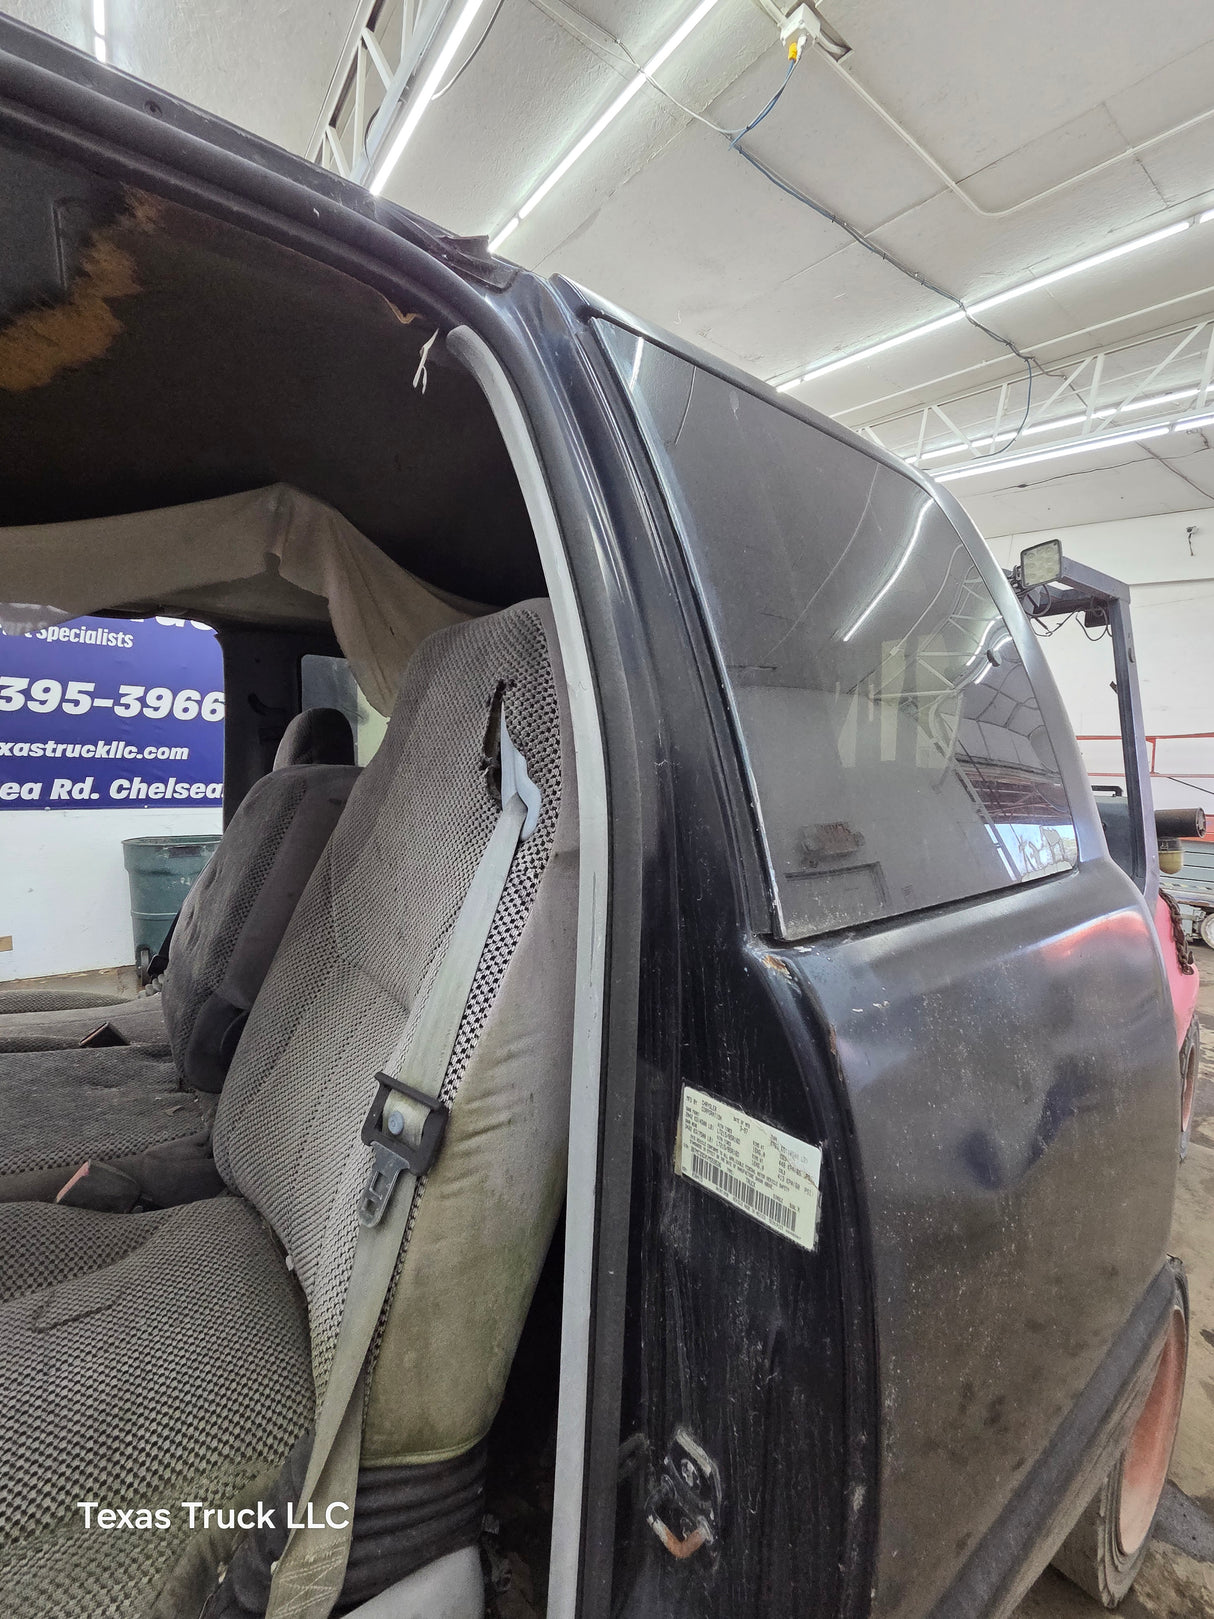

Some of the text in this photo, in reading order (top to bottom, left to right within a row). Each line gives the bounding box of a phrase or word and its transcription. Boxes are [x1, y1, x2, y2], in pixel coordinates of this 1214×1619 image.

[0, 676, 225, 722] 395-3966
[0, 740, 189, 760] xastruckllc.com
[50, 776, 100, 800] Rd.
